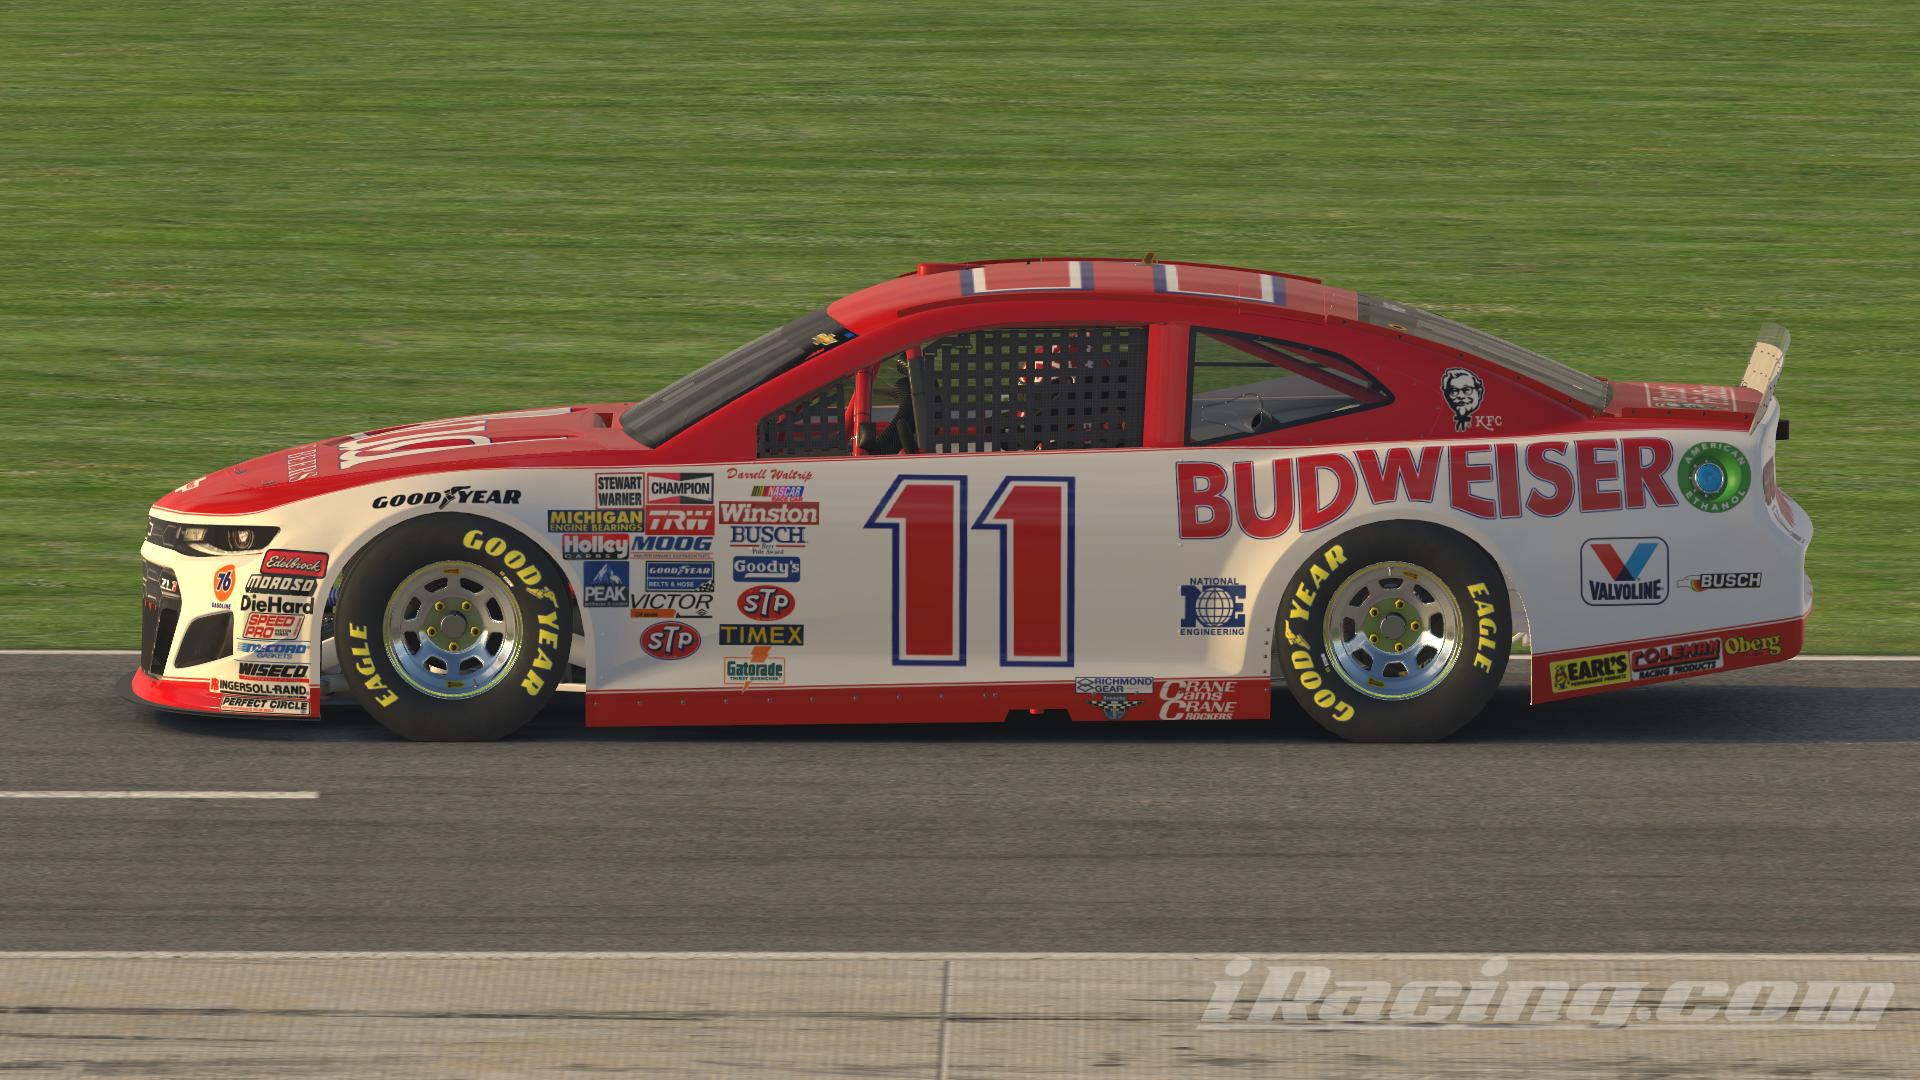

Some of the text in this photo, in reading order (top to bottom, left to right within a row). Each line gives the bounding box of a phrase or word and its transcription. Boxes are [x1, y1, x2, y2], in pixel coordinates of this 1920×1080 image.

[1475, 415, 1502, 432] KFC
[1685, 443, 1745, 464] AMERICAN
[598, 477, 642, 490] STEWART
[727, 468, 813, 482] Darrell Waltrip
[651, 482, 709, 495] CHAMPION
[768, 486, 801, 497] NASCAR
[1175, 437, 1679, 540] BUDWEISER
[372, 486, 522, 509] GOODYEAR
[598, 492, 642, 506] WARNER
[1686, 490, 1745, 511] ETHANOL
[550, 511, 643, 524] MICHIGAN
[649, 510, 712, 530] TRW
[720, 503, 817, 523] Winston
[550, 523, 643, 532] ENGINE BEARINGS
[730, 526, 806, 543] BUSCH
[563, 535, 628, 558] Holley
[632, 536, 712, 551] MOOG
[266, 556, 321, 572] Edelbrock
[649, 565, 711, 575] GOODYEAR
[734, 560, 800, 578] Goody's
[863, 475, 1075, 667] 11
[216, 572, 231, 591] 76
[247, 575, 314, 592] MOROSO
[1190, 577, 1239, 585] NATIONAL
[1701, 573, 1762, 588] BUSCH
[585, 586, 626, 601] PEAK
[1589, 579, 1661, 601] VALVOLINE
[241, 595, 314, 614] DieHard
[631, 594, 713, 609] VICTOR
[743, 588, 789, 616] STP
[250, 614, 295, 627] SPEED
[463, 529, 561, 696] GOODYEAR
[245, 626, 274, 638] PRO
[720, 626, 802, 644] TIMEX
[1180, 628, 1245, 636] ENGINEERING
[1285, 544, 1355, 721] GOODYEAR
[1466, 582, 1497, 674] EAGLE
[647, 626, 693, 655] STP
[1724, 635, 1781, 655] Oberg
[1632, 639, 1721, 671] COLEMAN
[239, 663, 308, 678] WISECO
[349, 623, 399, 708] EAGLE
[727, 661, 782, 676] Gatorade
[1567, 654, 1627, 680] EARL'S
[1639, 661, 1716, 679] RACING PRODUCTS
[220, 679, 307, 695] INGERSOLL-RAND
[1094, 677, 1152, 686] RICHMOND
[1095, 685, 1124, 693] GEAR
[1159, 680, 1238, 700] CRANE
[223, 697, 268, 708] PERFECT
[270, 700, 307, 710] CIRCLE
[1158, 701, 1238, 721] CRANE
[1186, 713, 1232, 721] ROCKERS
